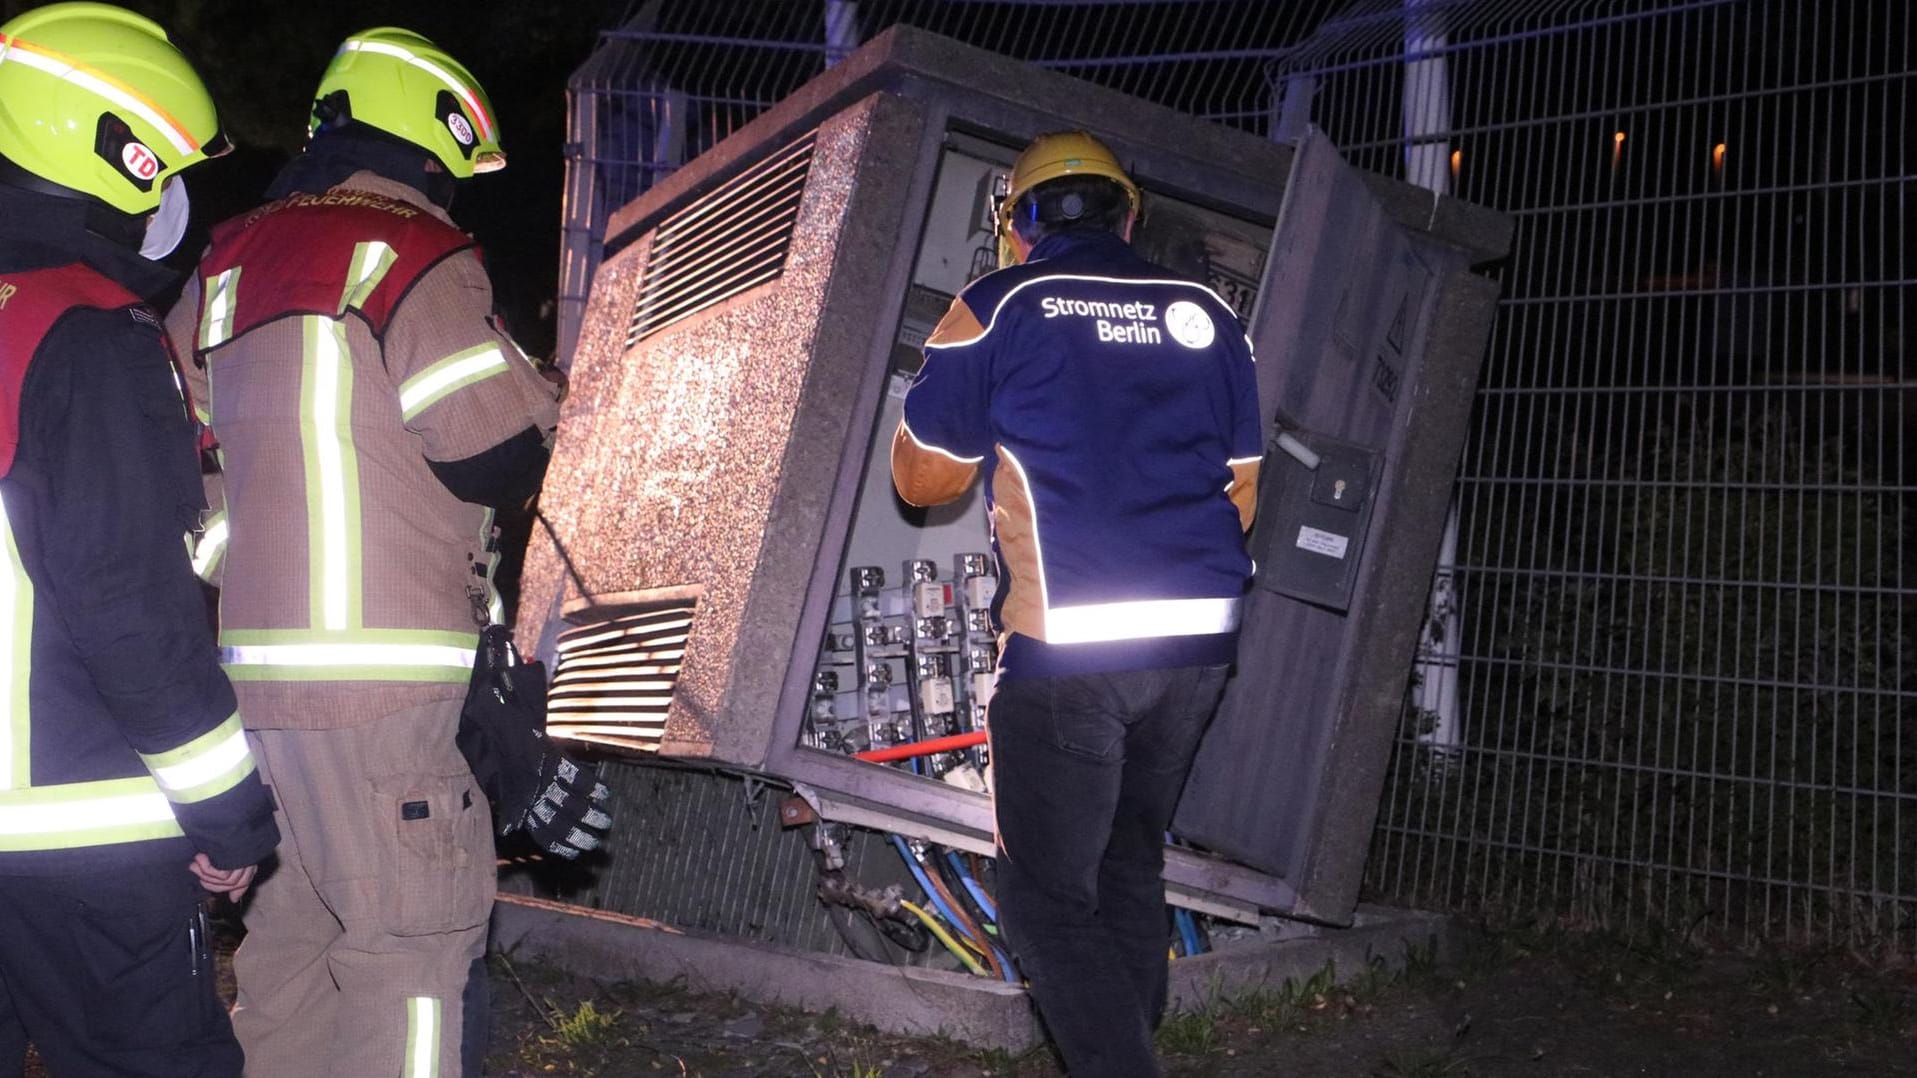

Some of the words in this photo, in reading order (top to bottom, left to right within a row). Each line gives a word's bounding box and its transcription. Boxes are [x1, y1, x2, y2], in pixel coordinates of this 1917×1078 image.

[450, 115, 472, 142] 3300
[129, 145, 156, 177] TD
[1041, 297, 1157, 320] Stromnetz
[1097, 320, 1161, 344] Berlin
